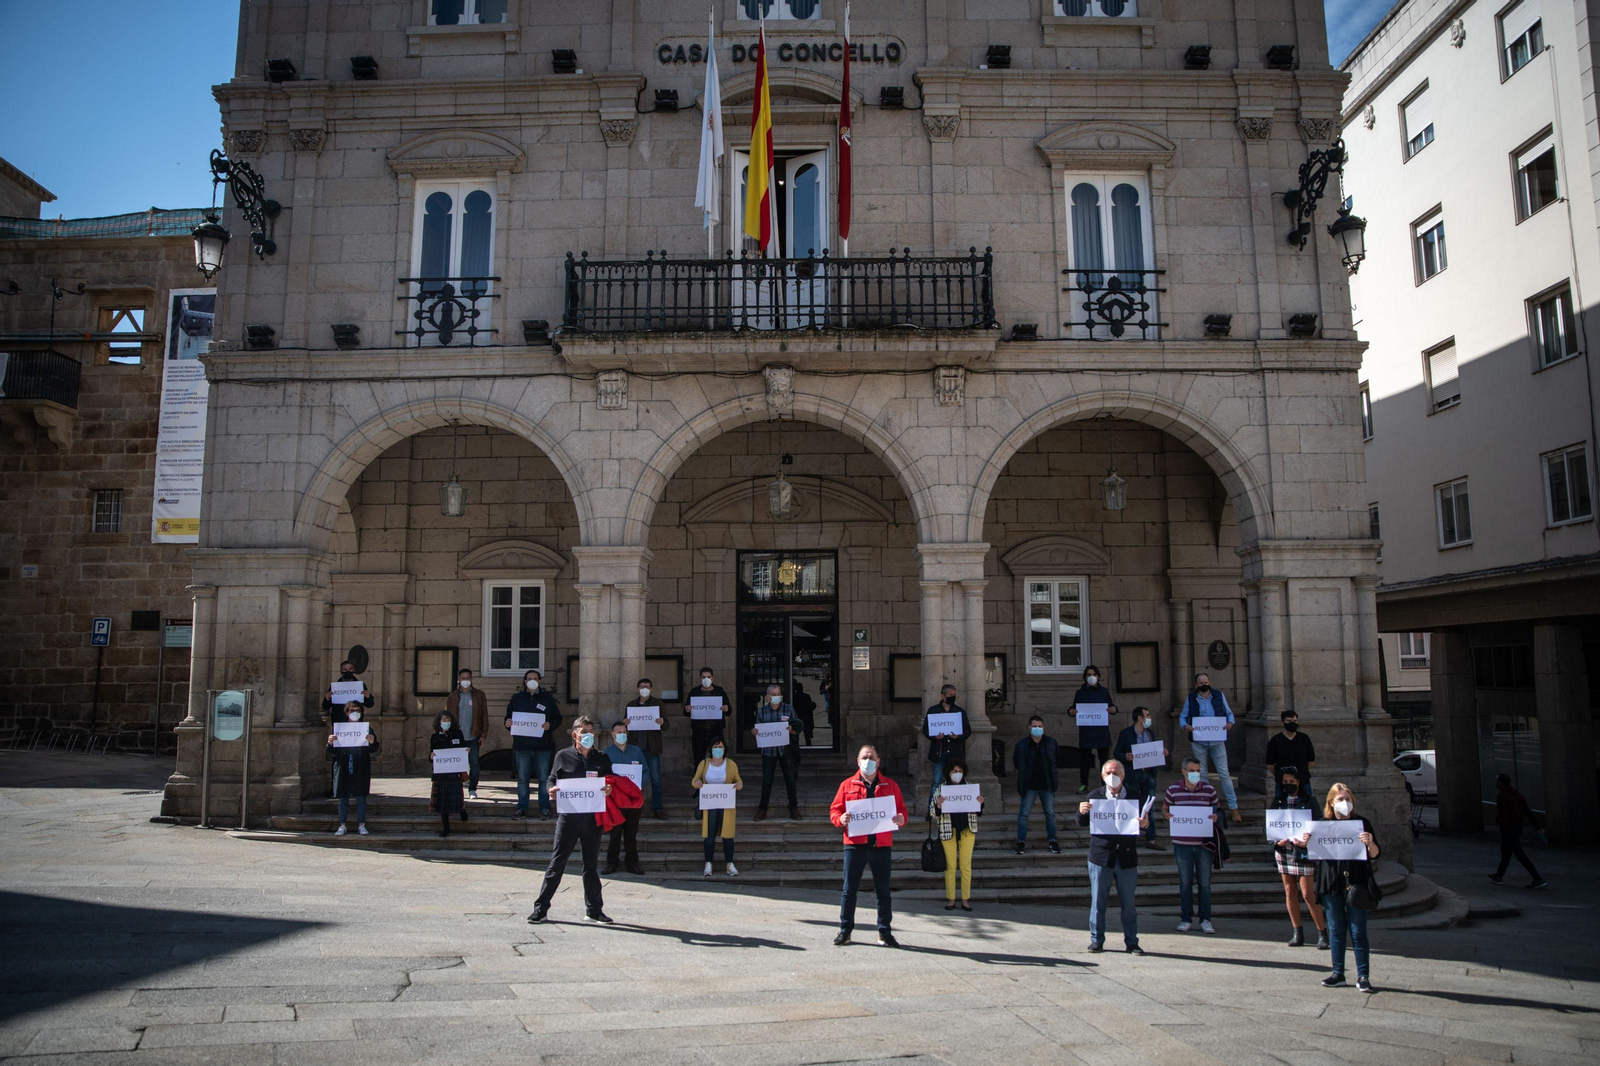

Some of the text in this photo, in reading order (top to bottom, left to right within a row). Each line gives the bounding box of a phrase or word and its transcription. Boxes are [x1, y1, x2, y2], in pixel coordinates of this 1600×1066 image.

[779, 42, 901, 62] CONCELLO
[97, 622, 105, 631] P
[629, 714, 654, 722] RESPETO
[1079, 713, 1102, 721] RESPETO
[513, 720, 539, 729] RESPETO
[930, 720, 955, 728] RESPETO
[1193, 724, 1219, 732] RESPETO
[1135, 750, 1159, 760] RESPETO
[435, 756, 462, 765] RESPETO
[560, 790, 595, 800] RESPETO
[702, 792, 729, 800] RESPETO
[851, 811, 886, 822] RESPETO
[1092, 812, 1129, 821] RESPETO
[1173, 817, 1204, 826] RESPETO
[1270, 820, 1302, 829] RESPETO
[1318, 836, 1354, 846] RESPETO
